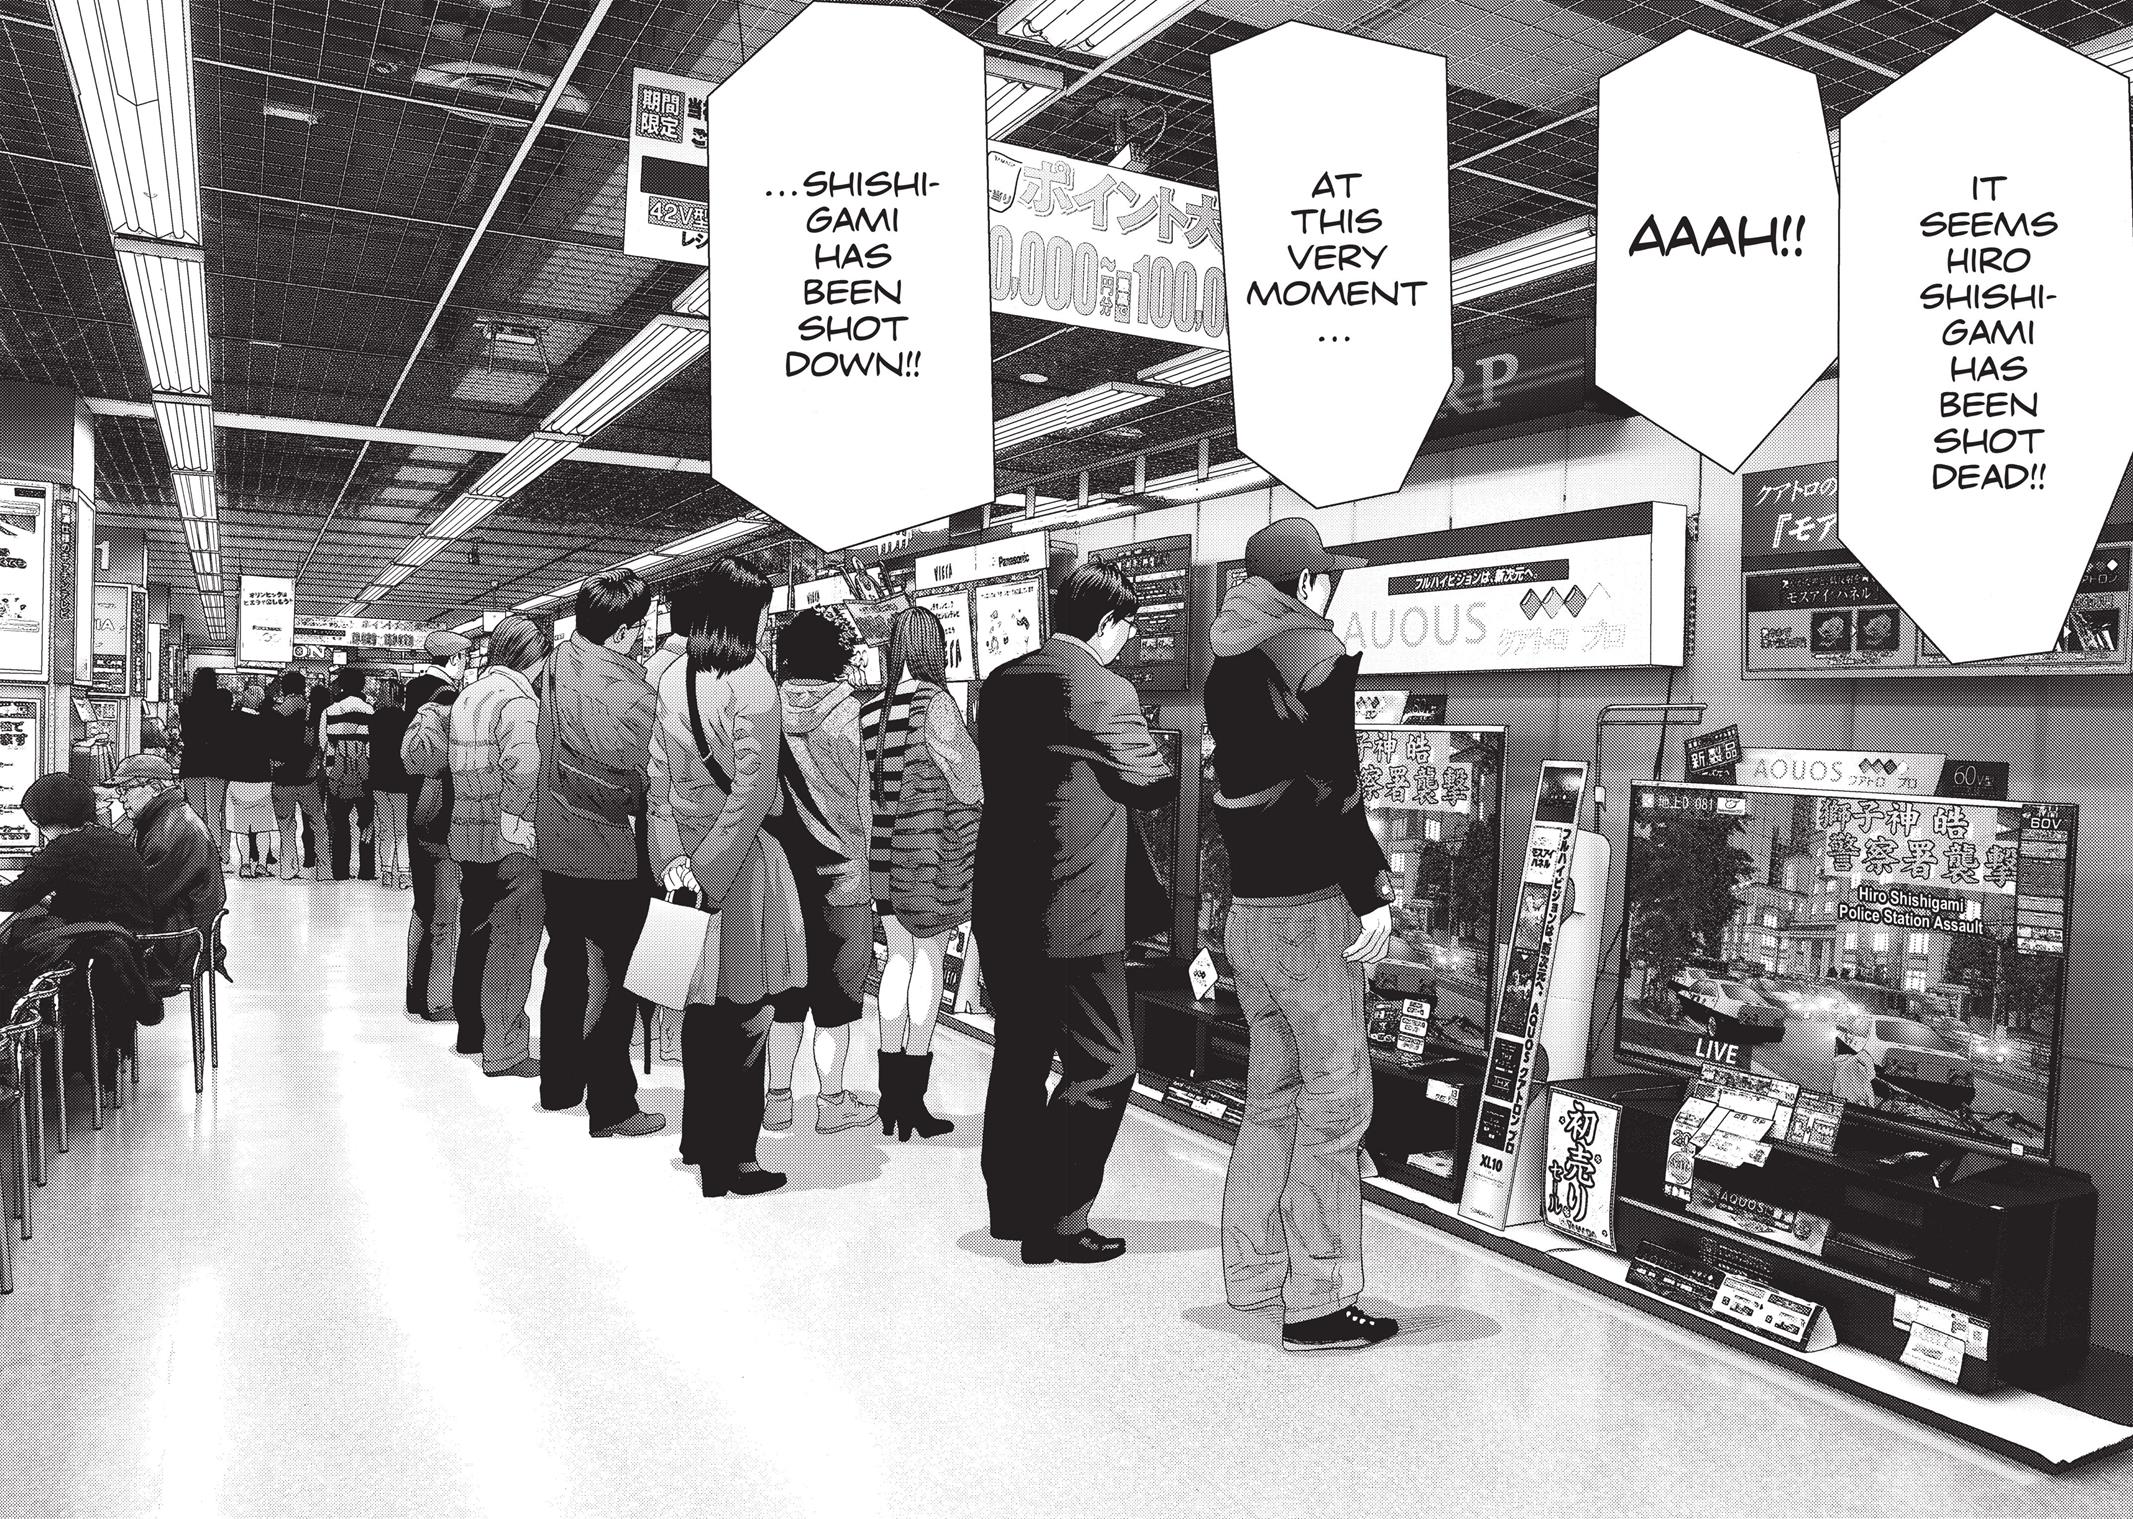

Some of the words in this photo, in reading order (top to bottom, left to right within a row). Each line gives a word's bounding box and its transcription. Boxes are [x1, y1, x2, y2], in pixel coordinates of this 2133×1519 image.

[643, 89, 680, 116] 期間
[641, 112, 679, 139] 限定
[1312, 171, 1362, 198] AT
[1973, 176, 2007, 201] IT
[650, 201, 709, 229] 42V型
[807, 207, 897, 233] GAMI
[1291, 209, 1382, 234] THIS
[1920, 212, 2058, 237] SEEMS
[1629, 214, 1805, 257] AAAH!!
[816, 244, 891, 269] HAS
[1288, 245, 1387, 270] VERY
[1948, 247, 2030, 273] HIRO
[805, 279, 901, 305] BEEN
[1247, 281, 1427, 306] MOMENT
[1920, 284, 2056, 310] SHISHI-
[798, 316, 908, 341] SHOT
[1943, 319, 2033, 345] GAMI
[786, 351, 921, 377] DOWN!!
[1951, 356, 2027, 382] HAS
[1941, 392, 2037, 417] BEEN
[1934, 428, 2045, 454] SHOT
[1933, 464, 2046, 490] DEAD!!
[1415, 567, 1538, 591] フルハイビジョンは、新次元へ。
[1690, 741, 1738, 770] 新製品
[2030, 816, 2062, 830] 60V
[1858, 885, 1887, 904] Hiro
[1890, 890, 1965, 915] Shishigami
[1839, 903, 1881, 923] Police
[1884, 907, 1931, 930] Station
[1933, 914, 1984, 936] Assault
[1695, 1037, 1740, 1065] LIVE
[1479, 1154, 1503, 1173] XL10
[1563, 1099, 1600, 1223] 初売り
[1548, 1158, 1565, 1216] セール
